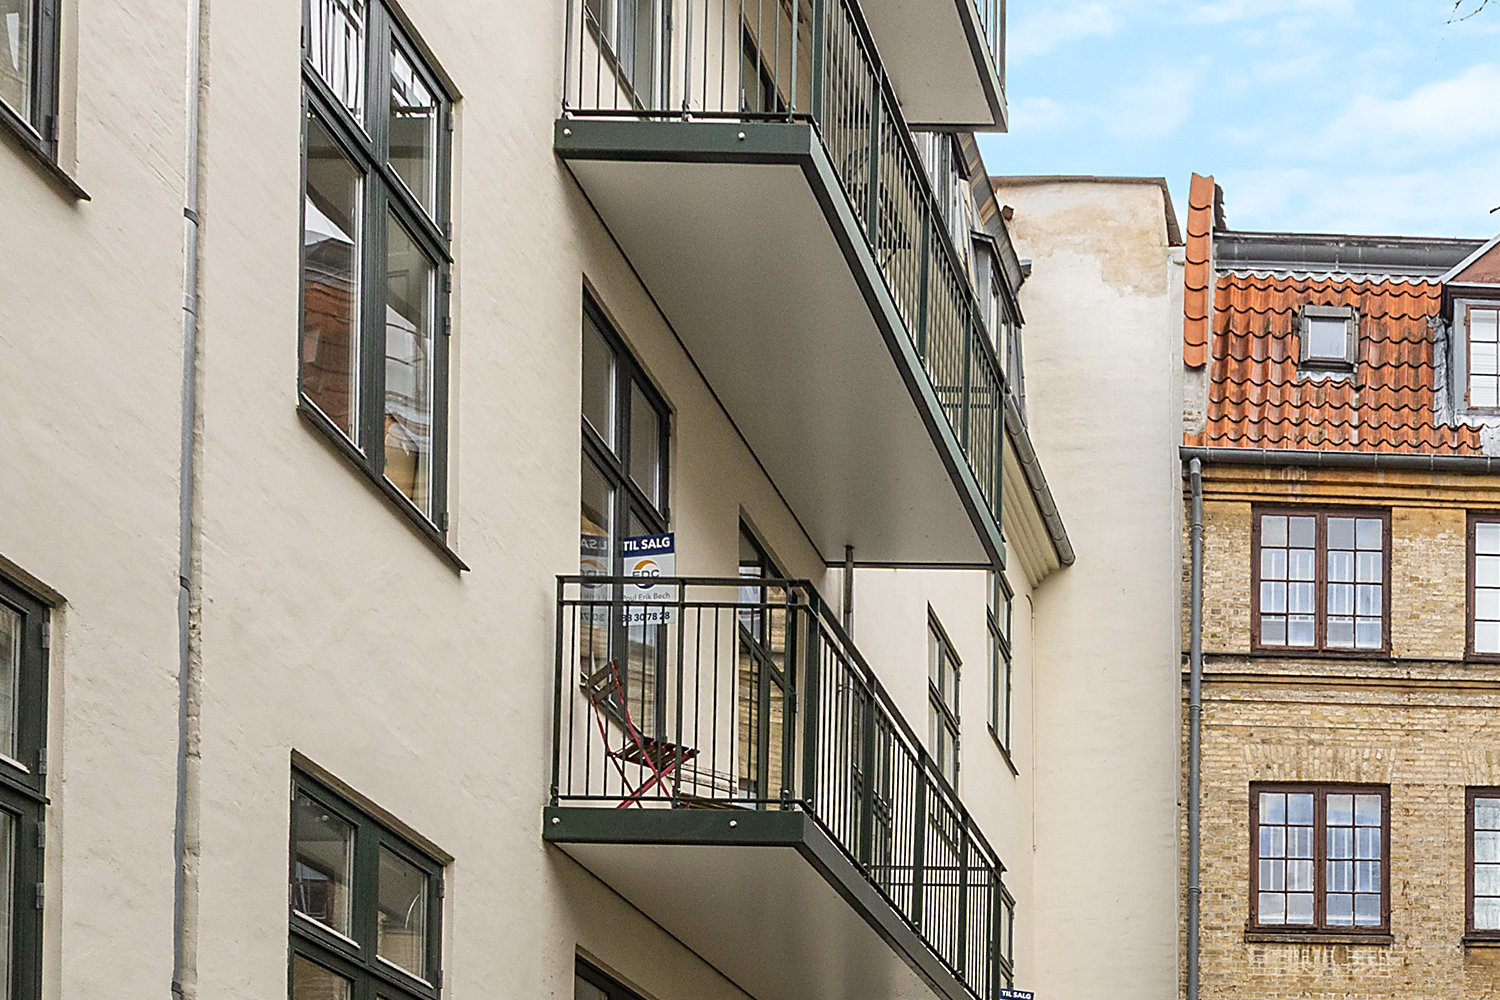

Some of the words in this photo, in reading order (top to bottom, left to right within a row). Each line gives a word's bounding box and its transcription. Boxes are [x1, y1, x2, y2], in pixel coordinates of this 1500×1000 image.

[623, 540, 639, 551] TIL
[641, 537, 670, 550] SALG
[634, 613, 645, 622] 30
[647, 612, 658, 621] 78
